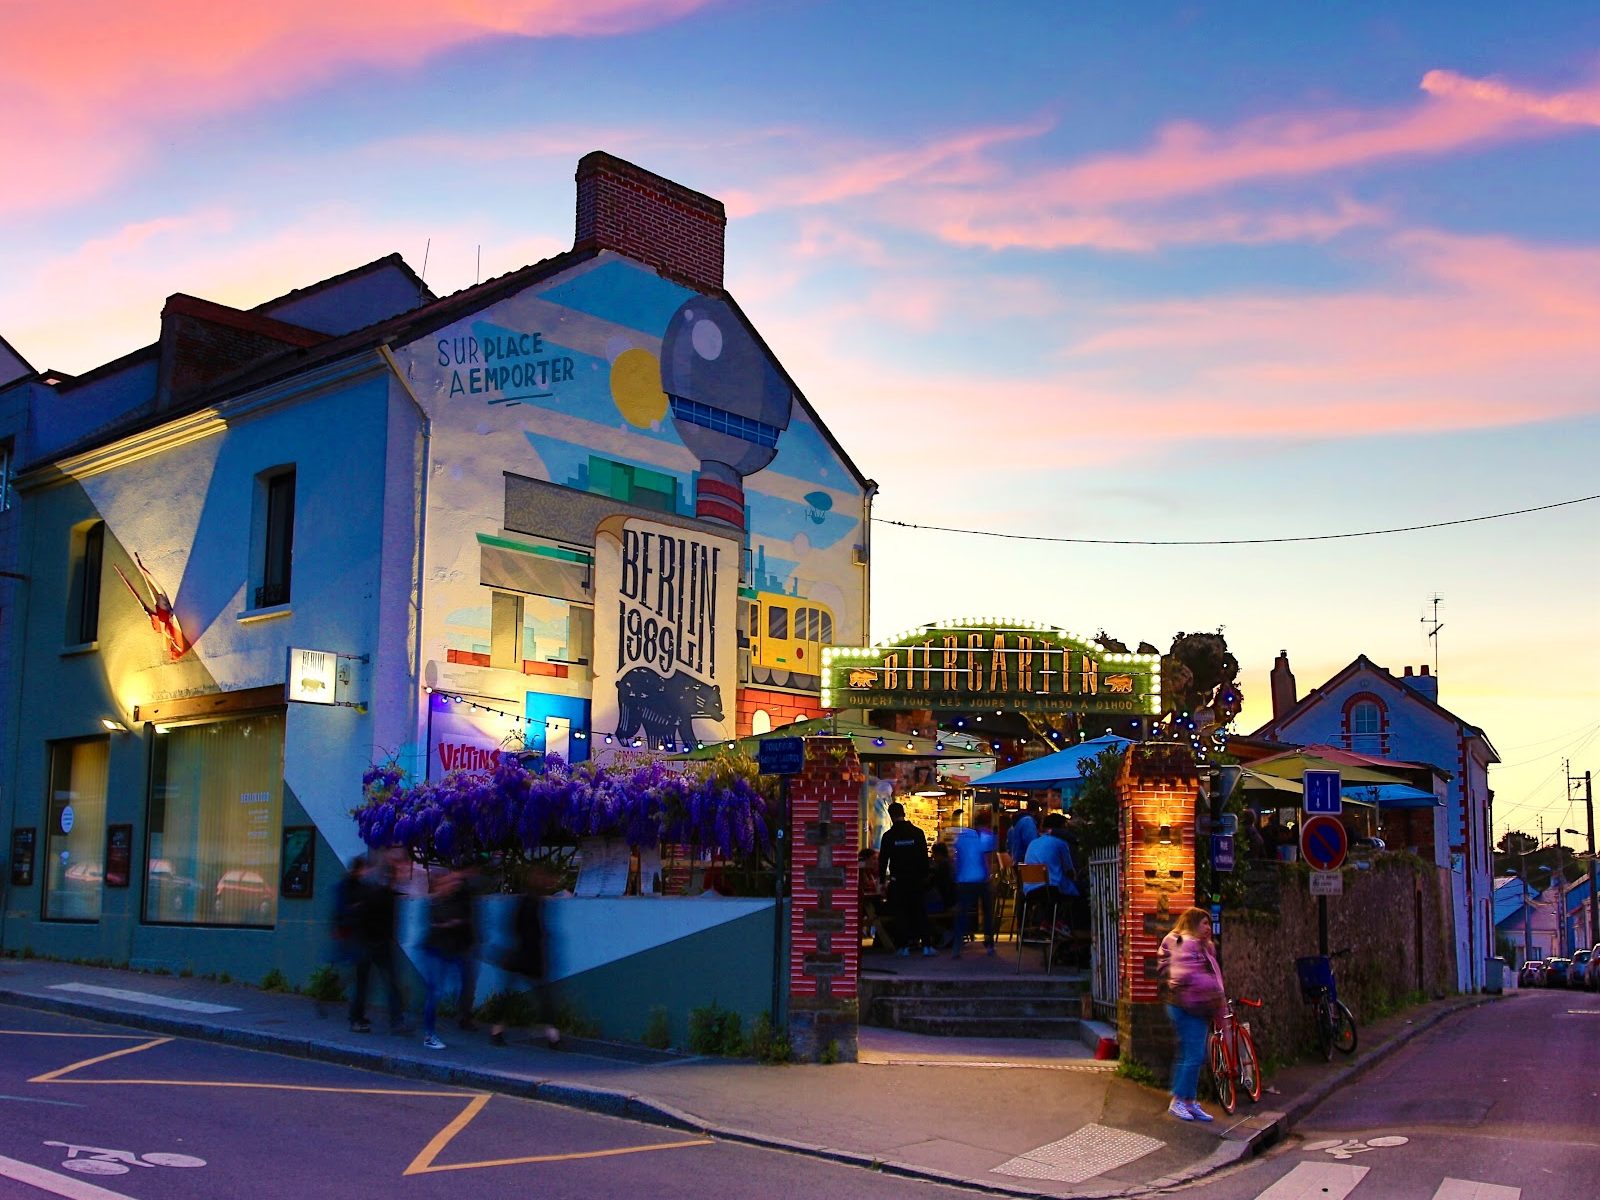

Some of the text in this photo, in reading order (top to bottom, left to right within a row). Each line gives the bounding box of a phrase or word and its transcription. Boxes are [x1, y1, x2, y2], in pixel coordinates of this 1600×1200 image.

[437, 332, 543, 366] SUR PLACE
[469, 356, 574, 394] EMPORTER
[619, 528, 721, 679] BERLIN
[616, 599, 675, 674] 1989
[883, 633, 1099, 695] BIERGARTEN
[849, 695, 893, 706] OUVERT
[902, 696, 931, 706] TOUS
[939, 698, 961, 708] LES
[969, 698, 1006, 709] JOURS
